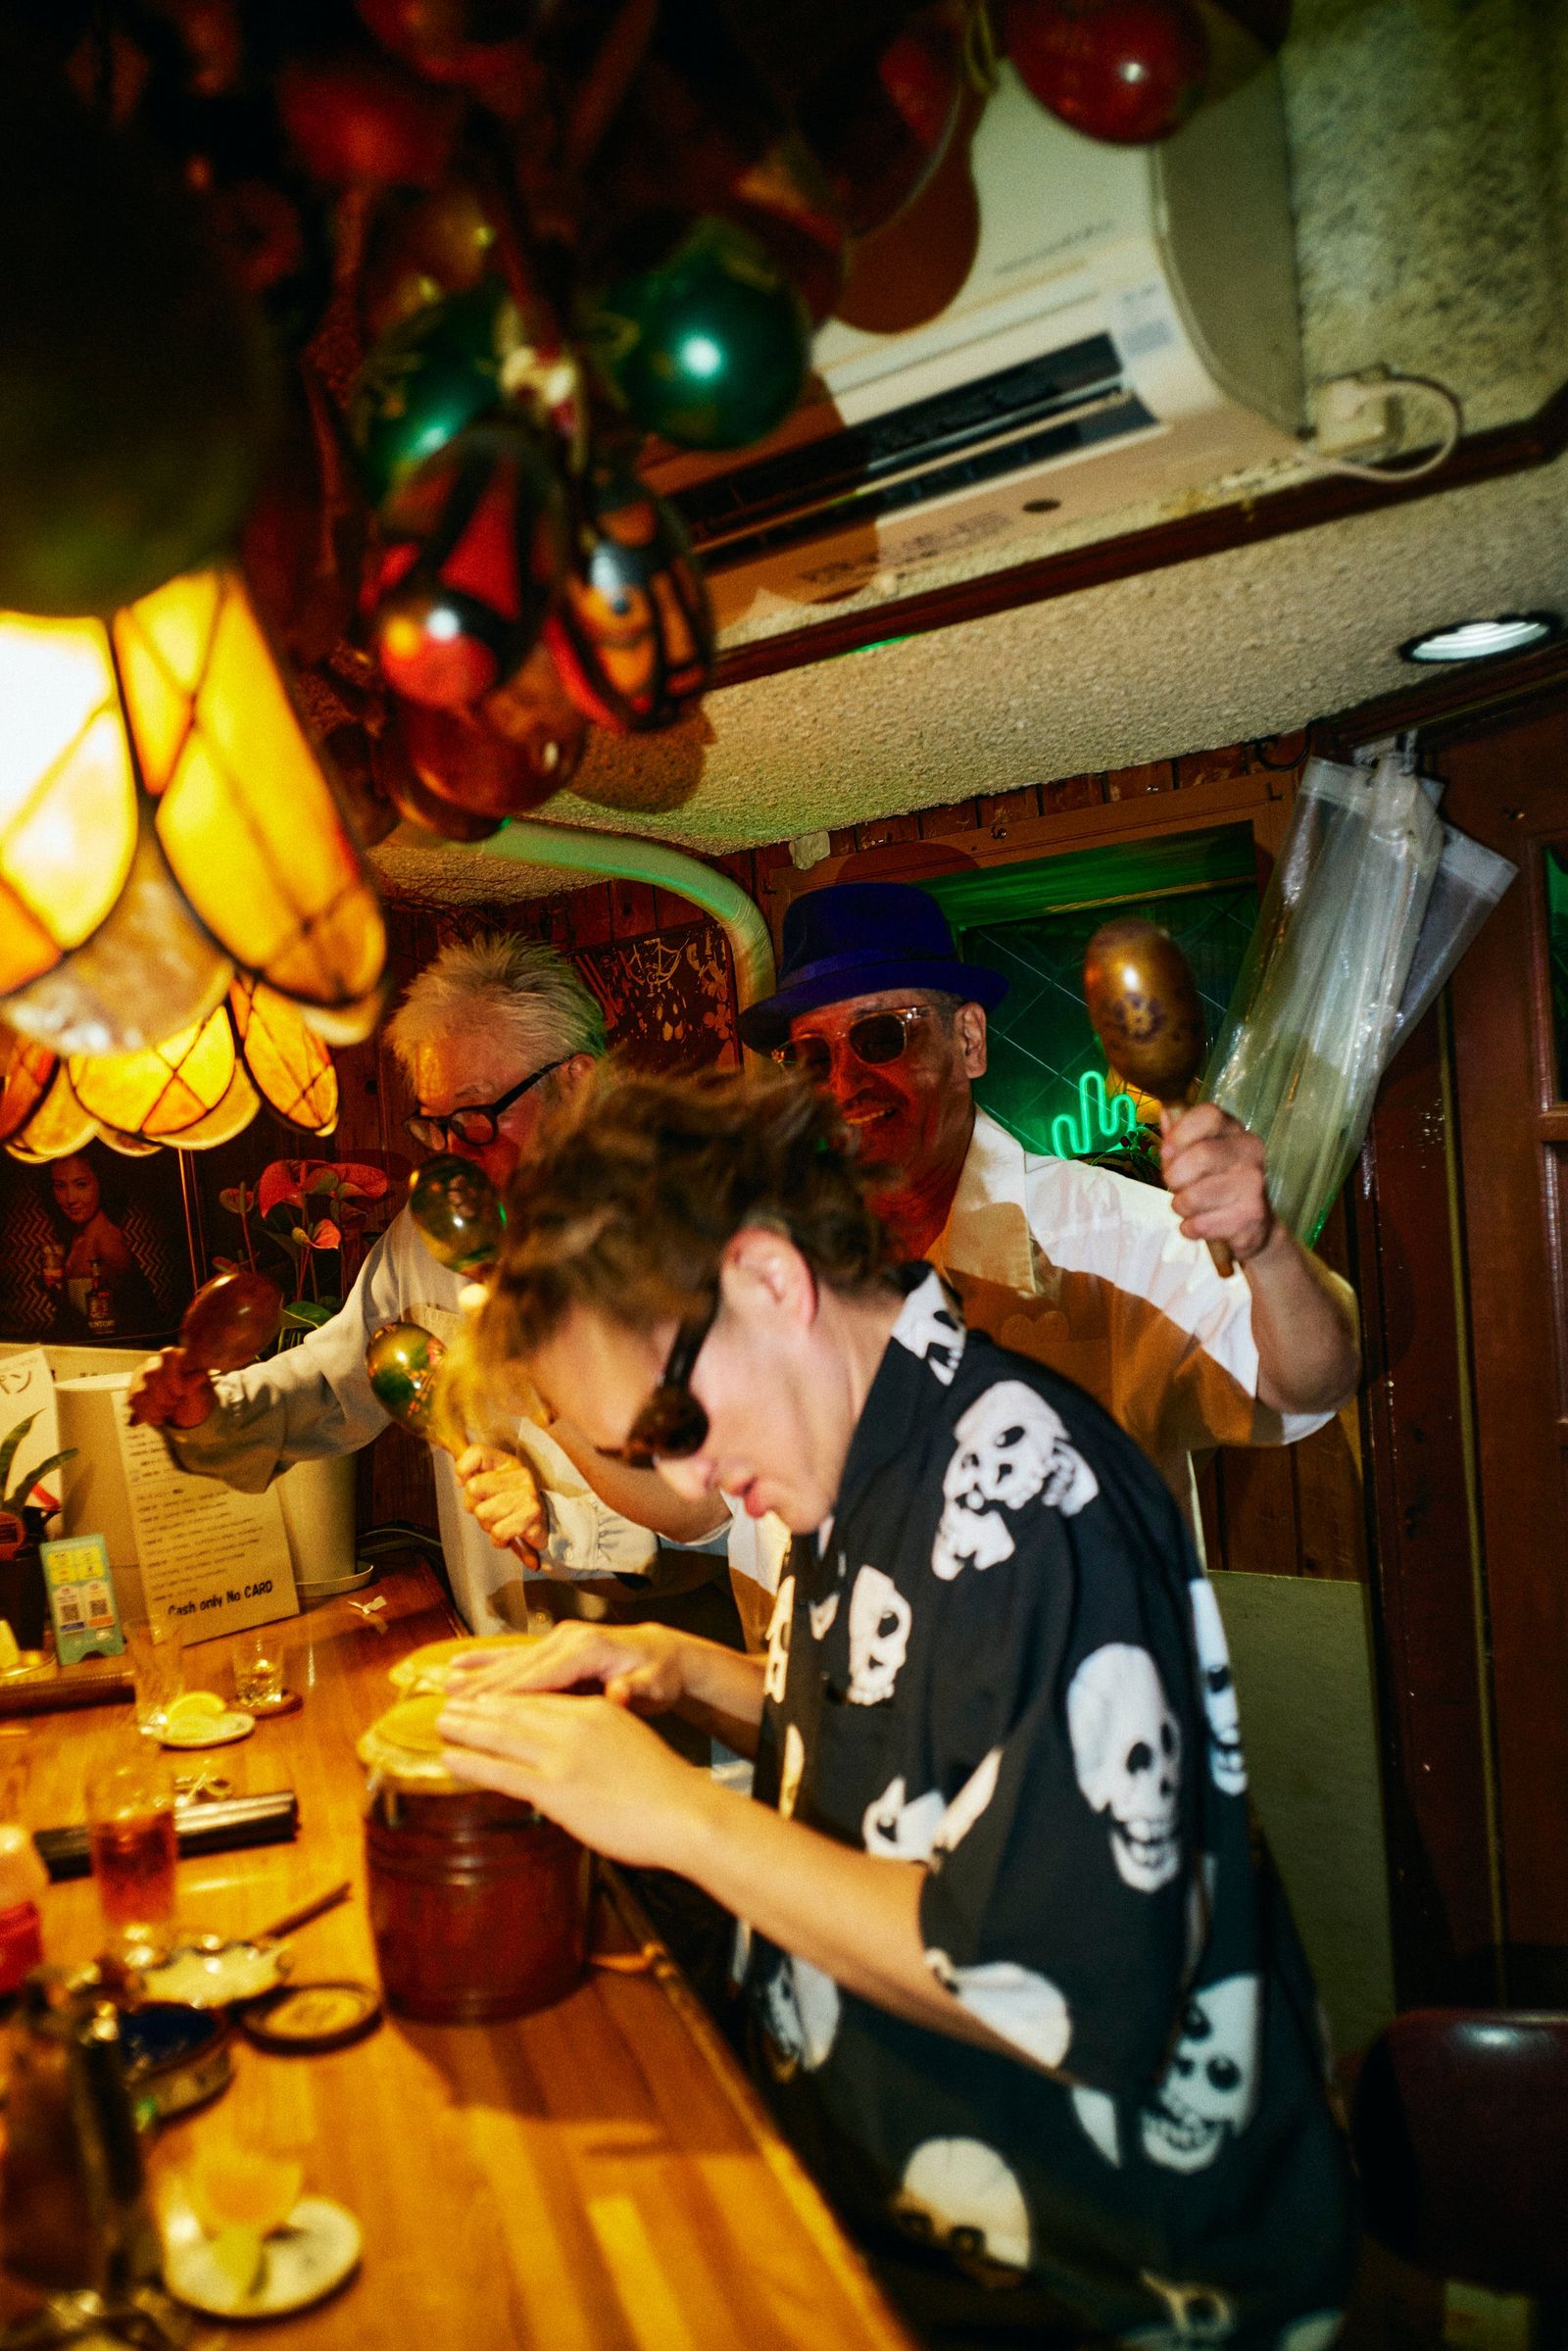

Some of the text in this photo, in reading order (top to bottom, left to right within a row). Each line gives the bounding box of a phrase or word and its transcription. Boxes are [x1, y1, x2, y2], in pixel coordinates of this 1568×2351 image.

[168, 1600, 196, 1616] Cash
[199, 1593, 222, 1610] only
[226, 1590, 241, 1603] No
[243, 1580, 273, 1598] CARD
